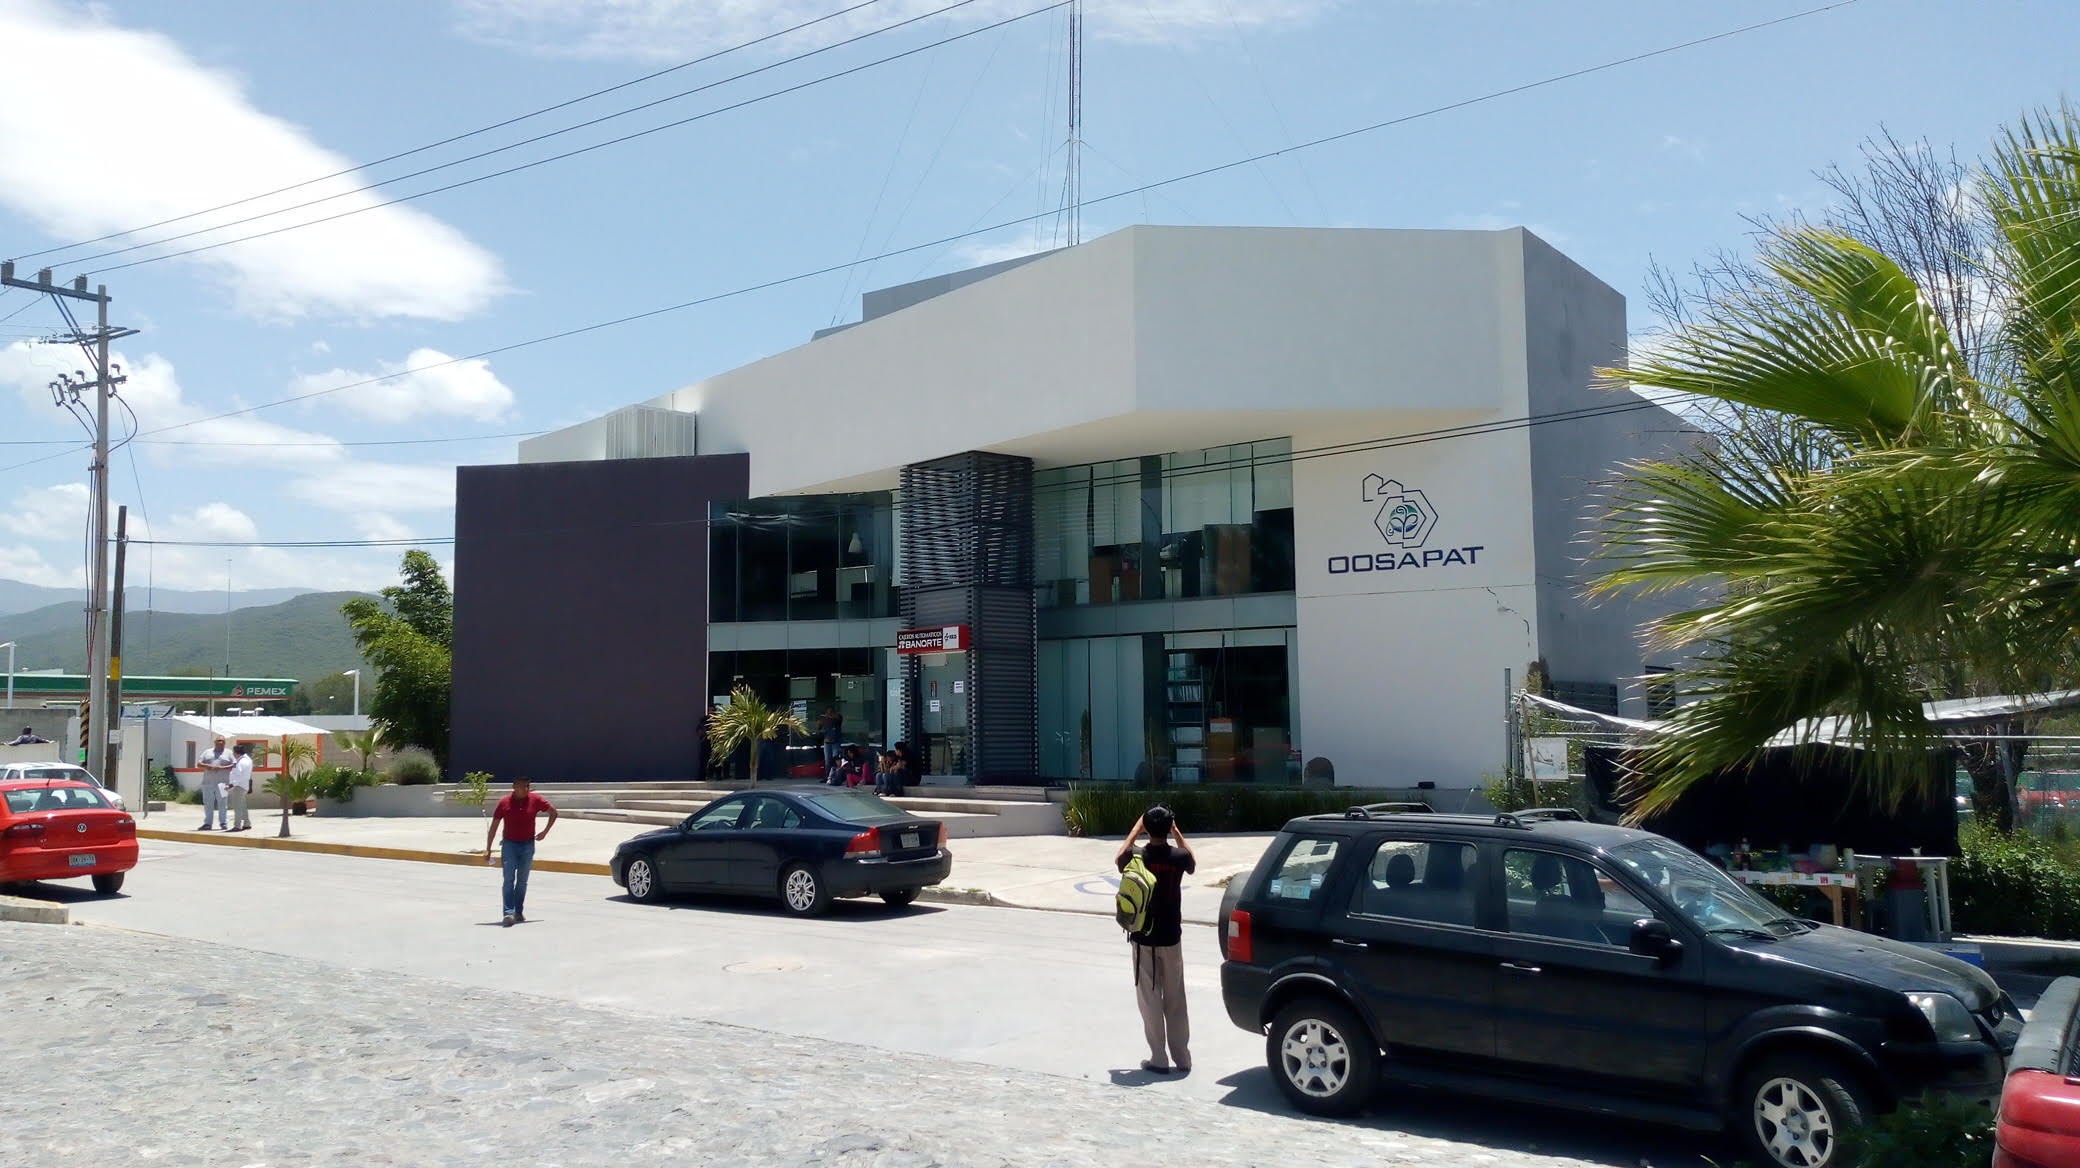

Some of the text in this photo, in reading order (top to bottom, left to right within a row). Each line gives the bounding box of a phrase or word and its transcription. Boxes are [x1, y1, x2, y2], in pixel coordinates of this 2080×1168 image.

[1328, 546, 1484, 574] OOSAPAT
[906, 638, 942, 649] BANORTE
[246, 687, 286, 696] PEMEX
